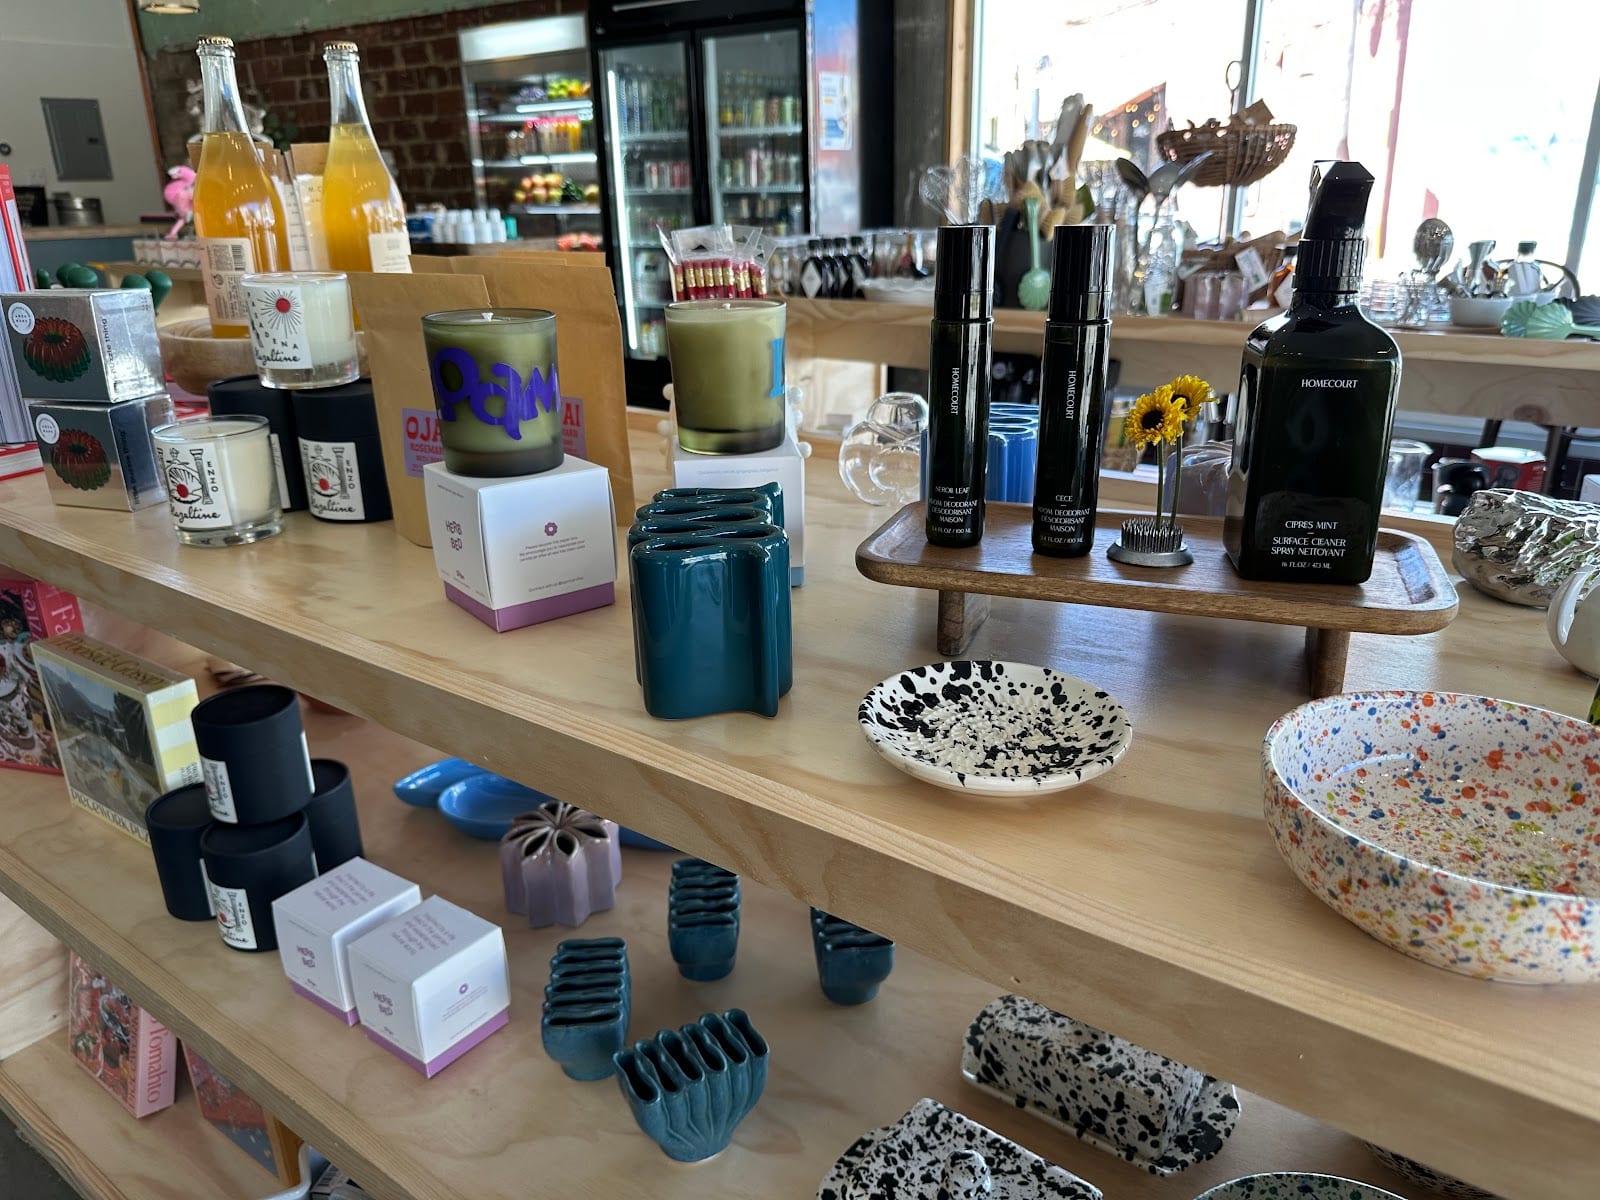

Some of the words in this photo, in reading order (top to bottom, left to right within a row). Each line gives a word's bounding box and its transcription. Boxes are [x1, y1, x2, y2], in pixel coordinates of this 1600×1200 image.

[1301, 378, 1359, 389] HOMECOURT
[950, 367, 960, 416] HOMECOURT
[1065, 370, 1077, 421] HOMECOURT
[562, 402, 581, 428] AI
[406, 415, 441, 442] OJA
[955, 486, 970, 494] LEAF
[943, 499, 978, 508] DEODORANT
[1055, 494, 1073, 502] CECE
[1054, 507, 1090, 517] DEODORANT
[1284, 520, 1314, 529] CIPRES
[1316, 521, 1339, 530] MINT
[1272, 536, 1310, 546] SURFACE
[1311, 537, 1347, 547] CLEANER
[1271, 546, 1296, 556] SPRAY
[1298, 547, 1347, 557] NETTOYANT
